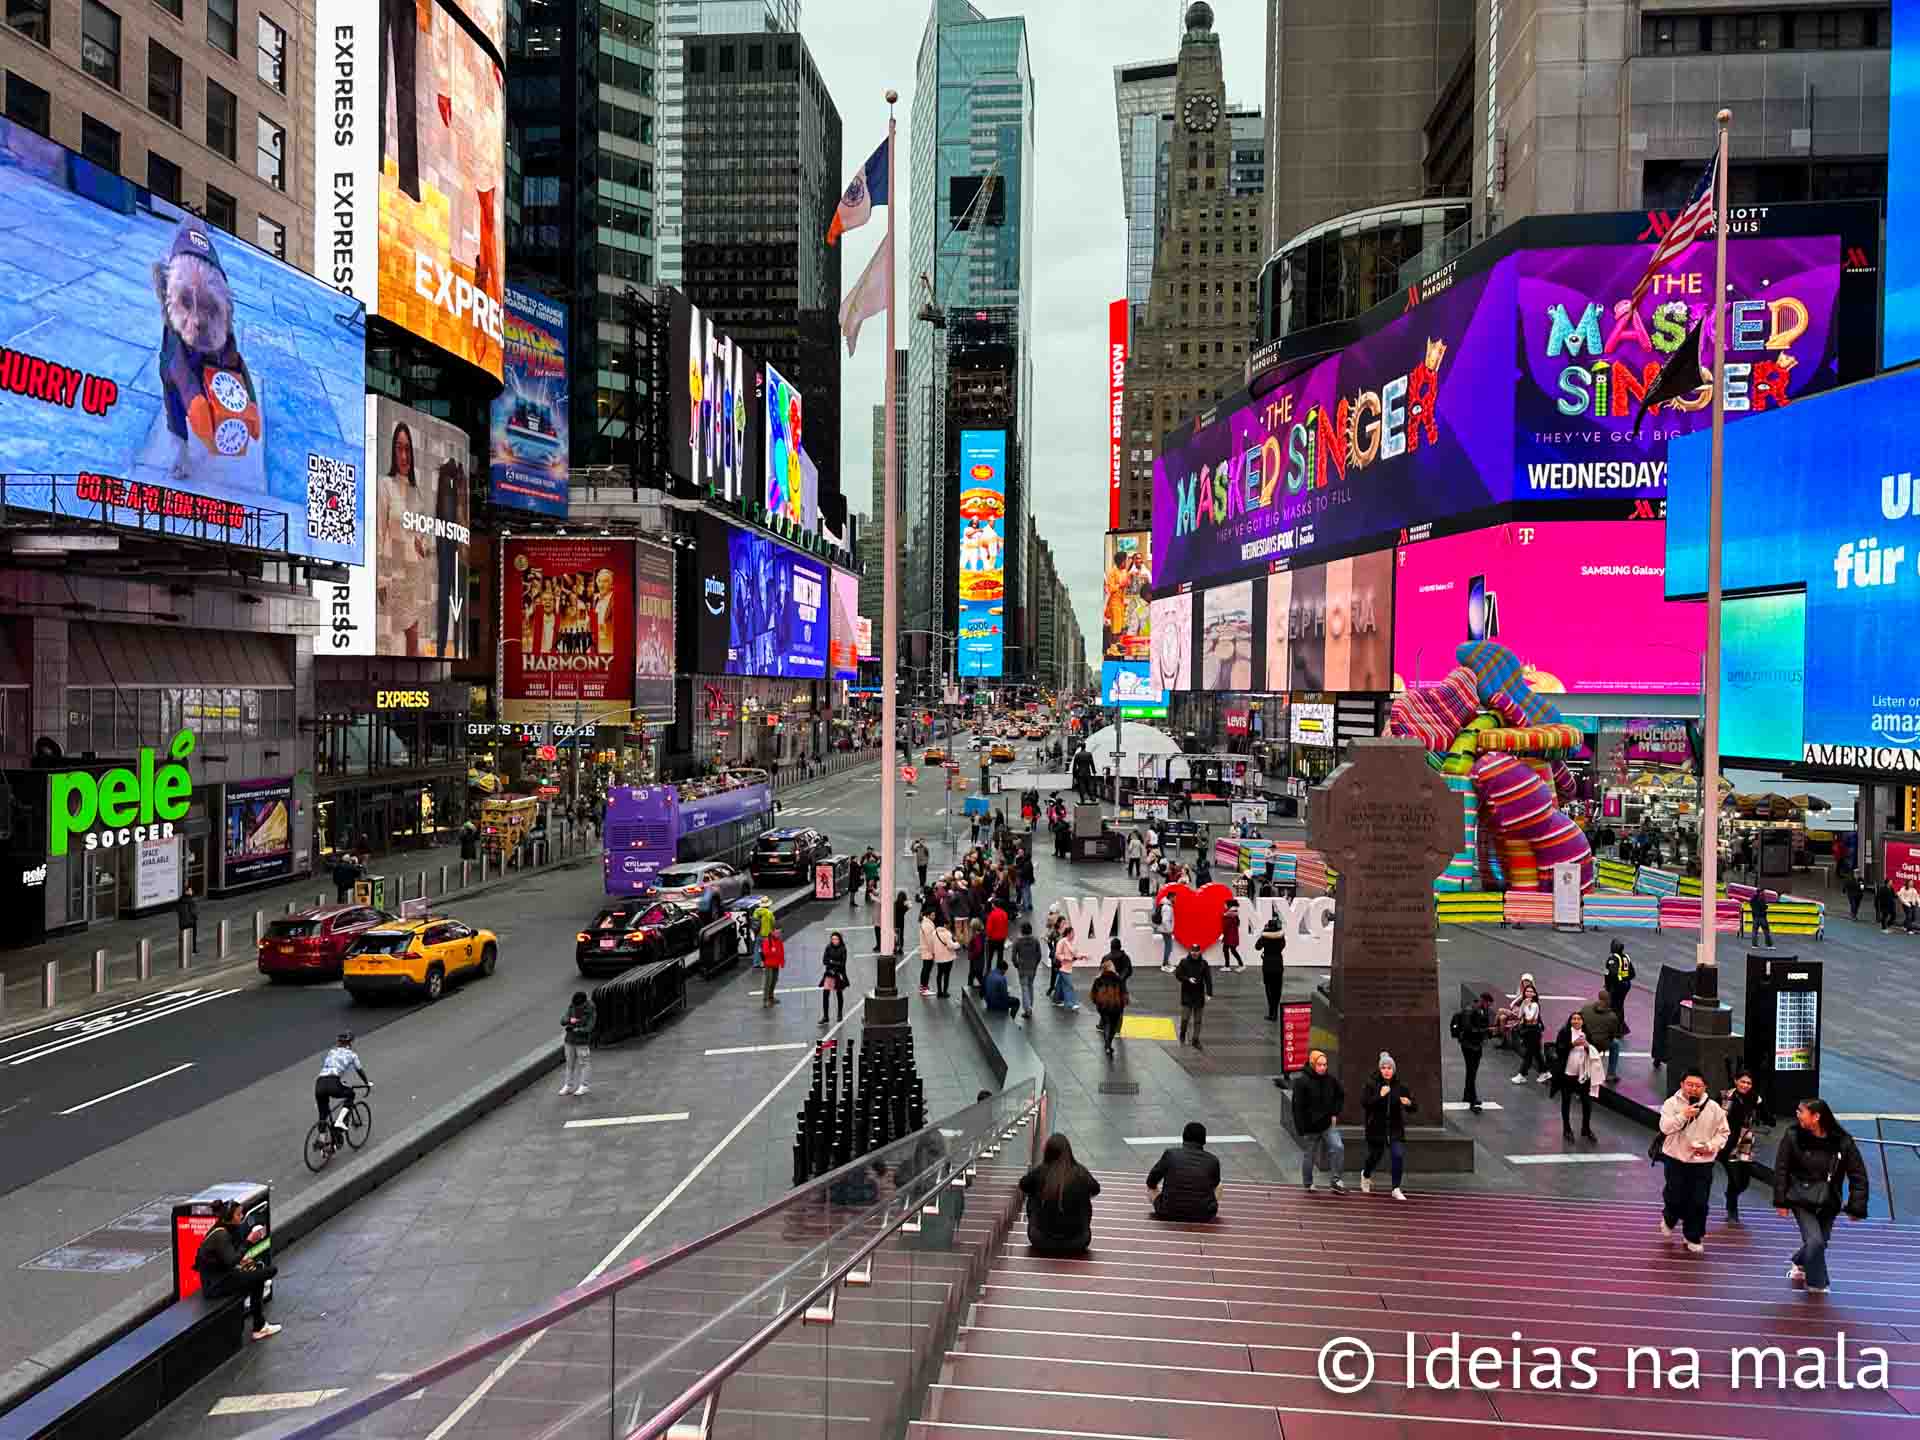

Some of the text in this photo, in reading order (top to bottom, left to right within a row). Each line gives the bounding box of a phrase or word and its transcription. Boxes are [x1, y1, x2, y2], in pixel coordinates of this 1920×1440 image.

[334, 25, 354, 147] EXPRESS
[1422, 260, 1457, 287] MARRIOTT
[1650, 272, 1703, 295] THE
[1422, 275, 1453, 300] MARQUIS
[1252, 340, 1283, 361] MARRIOTT
[1252, 353, 1278, 372] MARQUIS
[1112, 344, 1125, 388] NOW
[0, 347, 117, 415] HURRY UP
[1266, 393, 1294, 431] THE
[1653, 430, 1682, 442] BIG
[1177, 434, 1281, 537] MASKED
[1528, 461, 1667, 490] WEDNESDAY
[1282, 500, 1313, 521] MASKS
[1316, 496, 1329, 512] TO
[402, 511, 434, 534] SHOP
[435, 518, 446, 538] IN
[1277, 530, 1294, 553] FOX
[1581, 565, 1666, 578] SAMSUNG Galaxy
[1833, 536, 1905, 590] für
[704, 575, 726, 596] prime
[331, 585, 350, 649] RESS
[521, 654, 615, 672] HARMONY
[376, 690, 430, 708] EXPRESS
[1872, 694, 1905, 708] Listen
[523, 723, 596, 737] LUGAE
[48, 728, 196, 856] pelé
[85, 821, 175, 850] SOCCER
